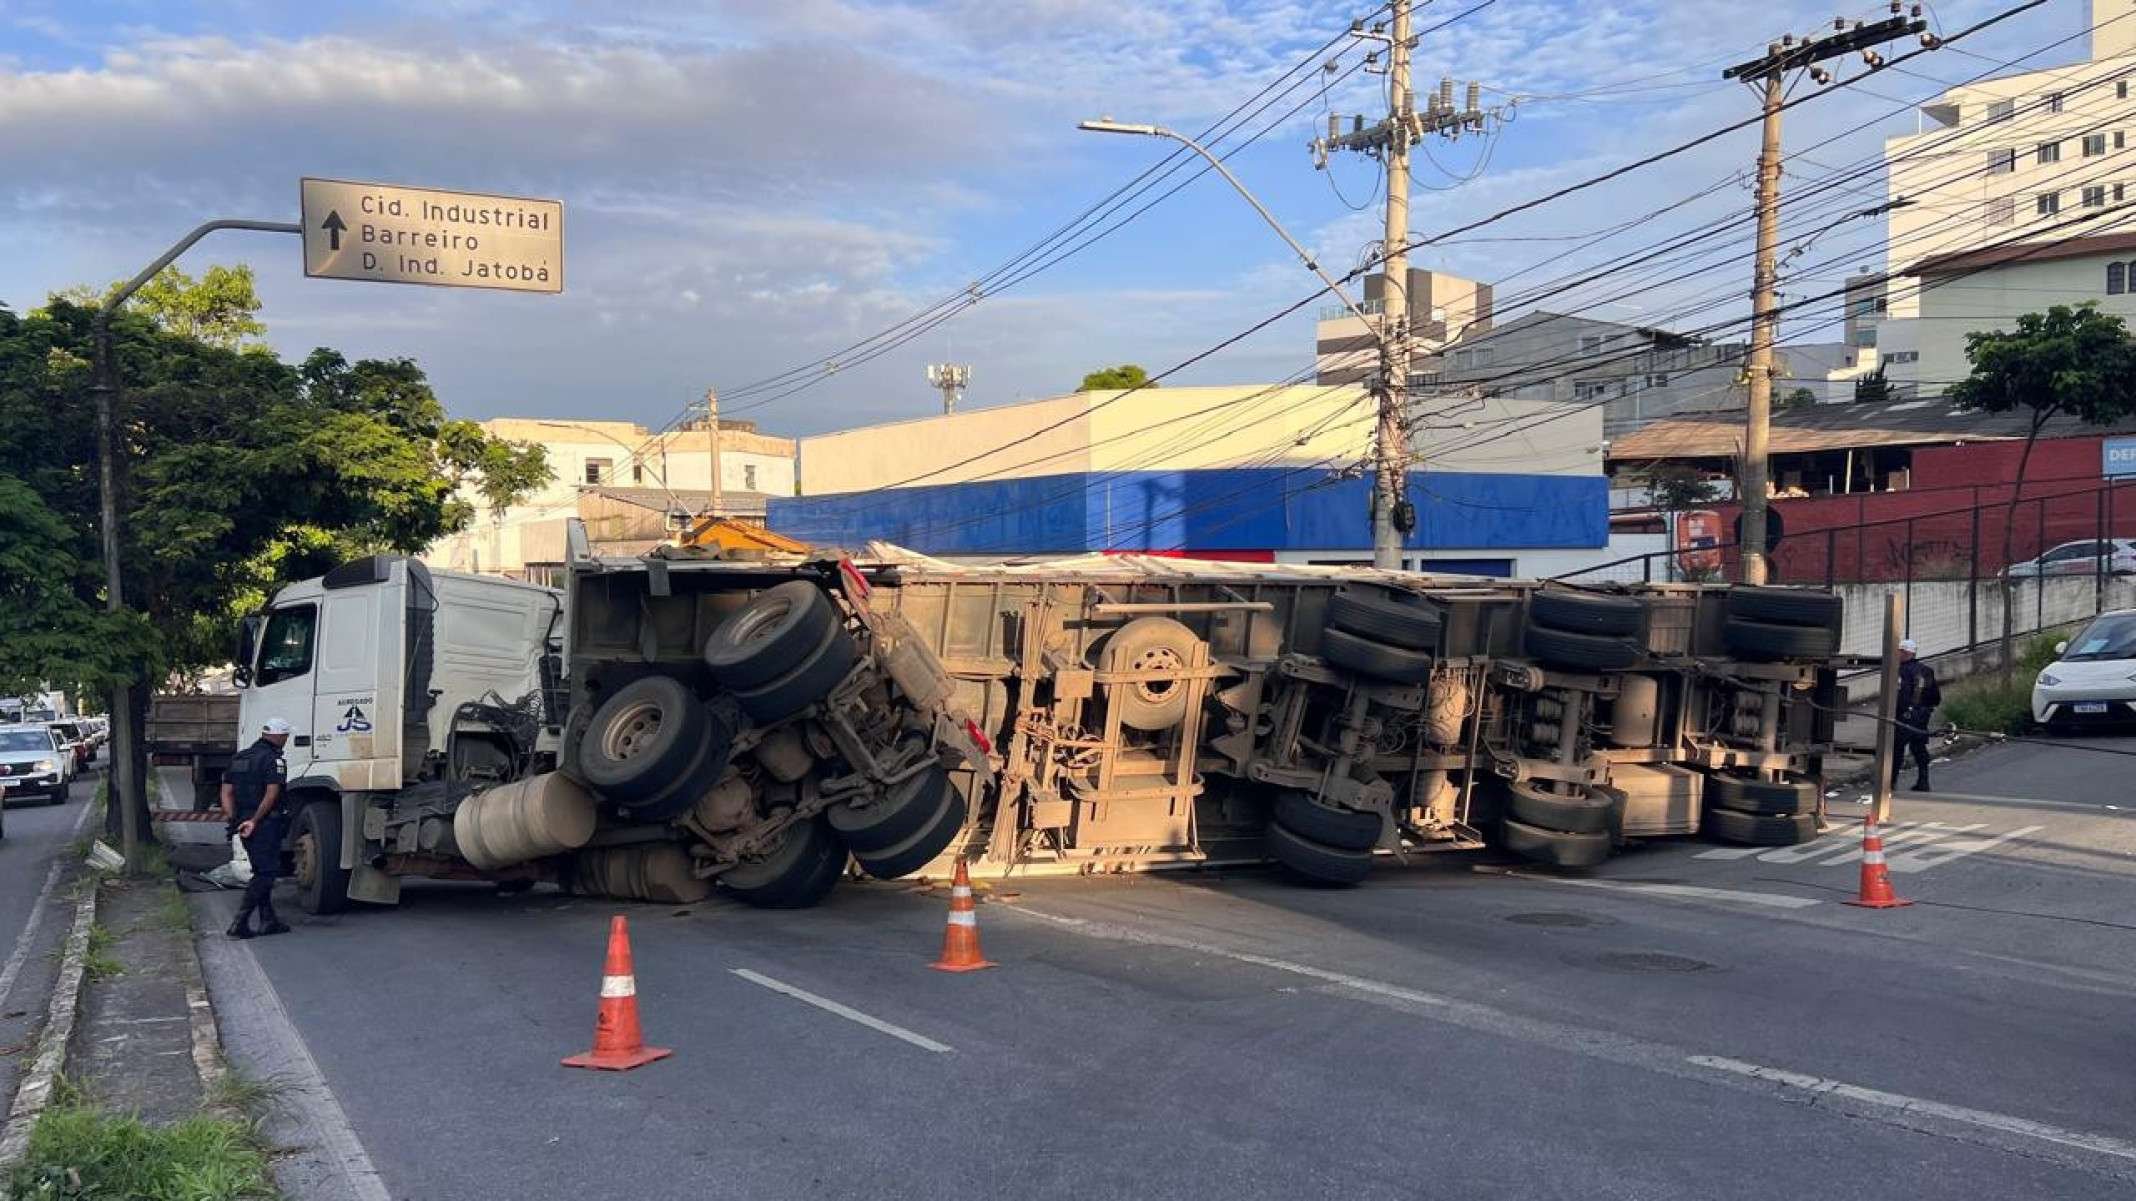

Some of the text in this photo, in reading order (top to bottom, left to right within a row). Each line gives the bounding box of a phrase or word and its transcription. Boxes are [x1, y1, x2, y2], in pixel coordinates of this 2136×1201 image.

[361, 195, 549, 231] Cid. Industrial
[361, 225, 479, 251] Barreiro
[363, 252, 549, 282] D. Ind. Jatobá
[336, 718, 372, 731] JS
